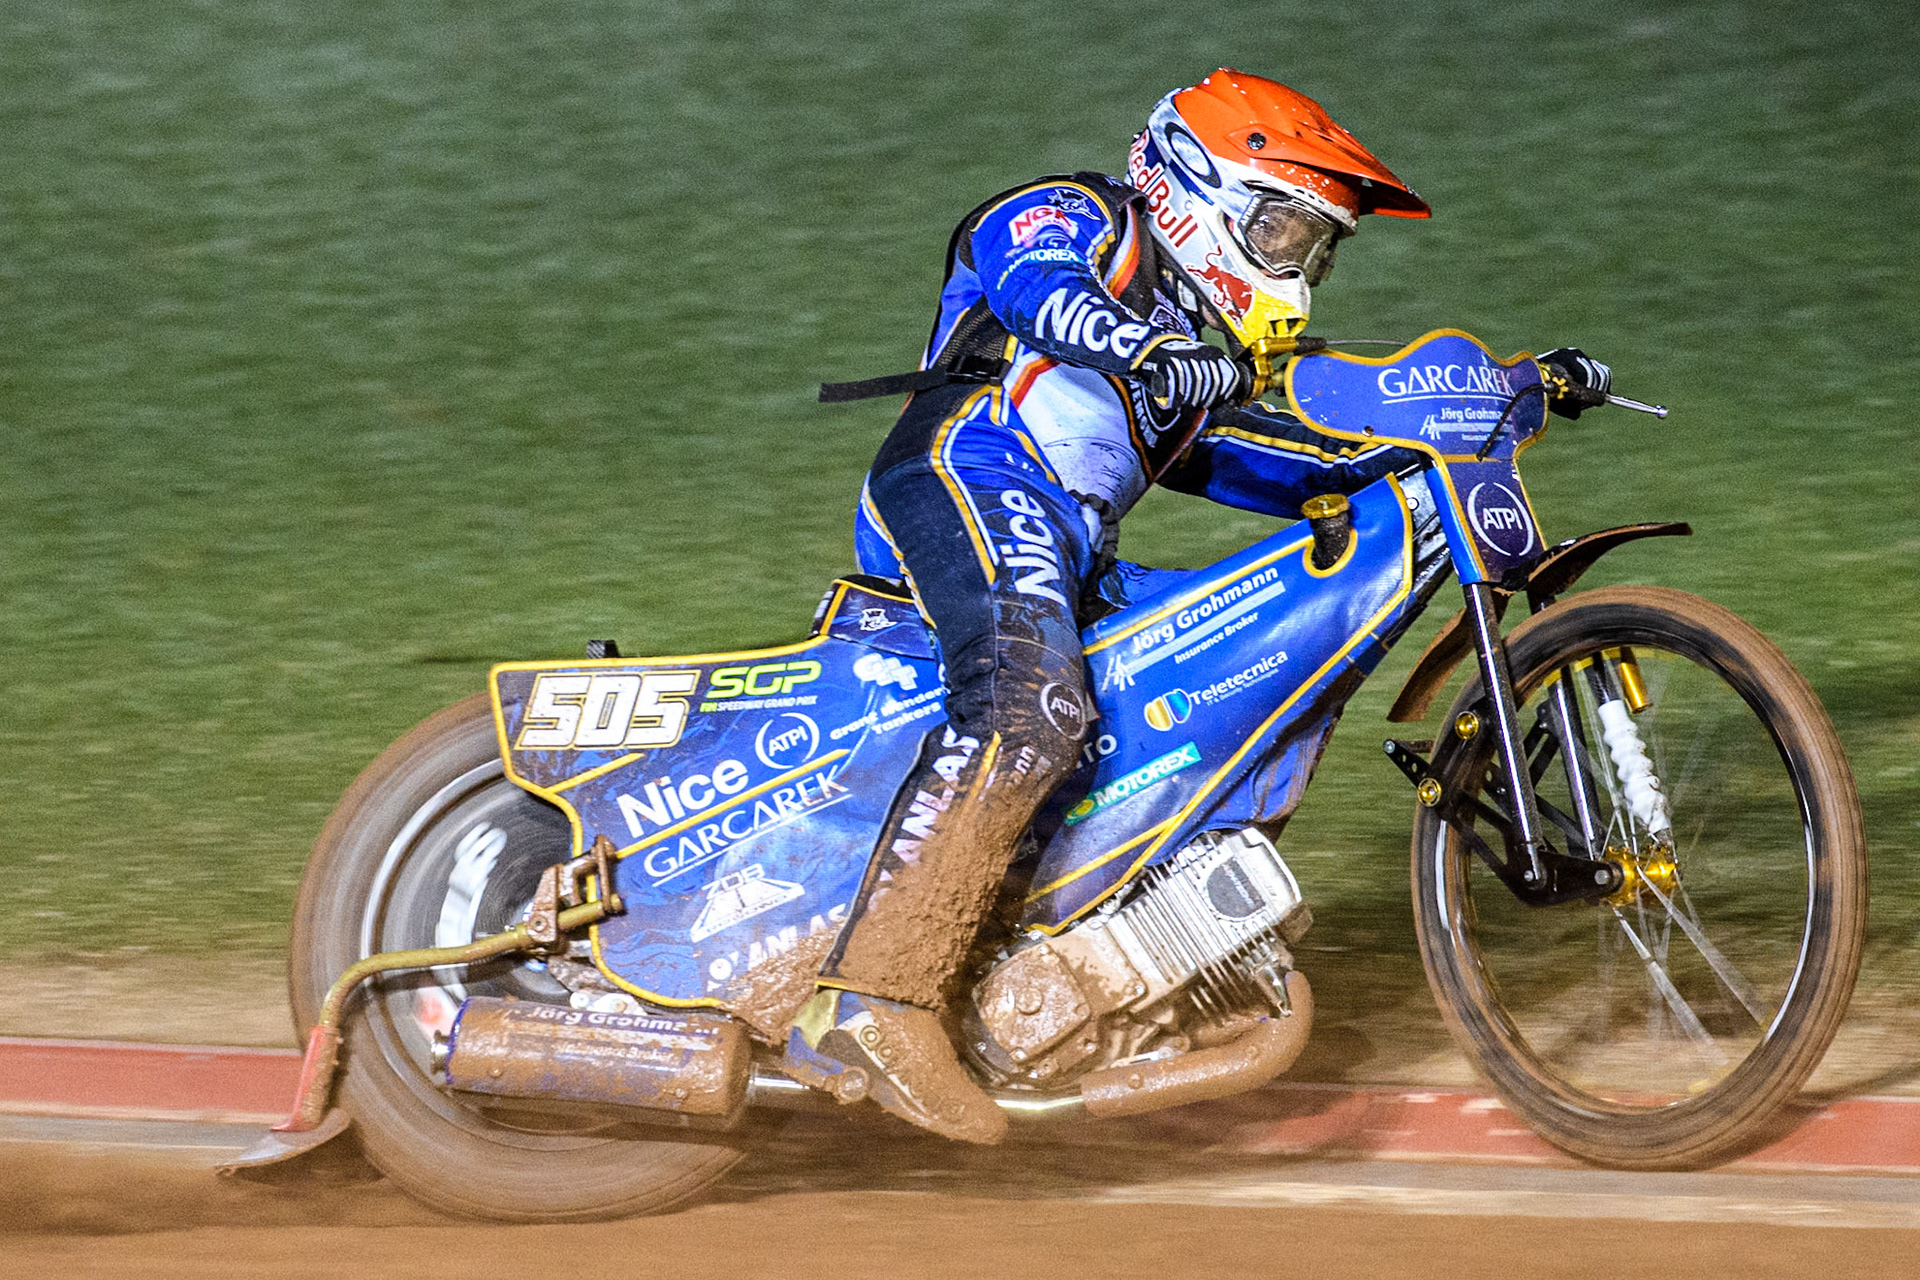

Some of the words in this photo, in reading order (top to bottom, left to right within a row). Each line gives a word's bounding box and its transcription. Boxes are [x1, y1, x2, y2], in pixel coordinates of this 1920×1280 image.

[1148, 179, 1198, 248] Bull
[1035, 287, 1150, 359] Nice
[1378, 364, 1516, 397] GARCAREK
[1440, 407, 1464, 422] Jörg
[1465, 406, 1512, 420] Grohma
[1483, 508, 1523, 530] ATPI
[1000, 489, 1067, 608] Nice
[1132, 622, 1176, 655] Jörg
[1176, 567, 1279, 629] Grohmann
[1174, 631, 1225, 665] Insurance
[1224, 611, 1259, 636] Broker
[699, 702, 718, 713] FIM
[717, 699, 765, 711] SPEEDWAY
[764, 697, 796, 709] GRAND
[796, 695, 818, 706] PRIX
[706, 660, 821, 698] SGP
[1189, 650, 1289, 705] Teletecnica
[514, 670, 701, 750] 505
[830, 711, 878, 740] Grant
[871, 702, 941, 734] Tankers
[769, 725, 808, 757] ATPI
[616, 758, 749, 838] Nice
[1093, 746, 1195, 808] MOTOREX
[643, 764, 851, 879] GARCAREK
